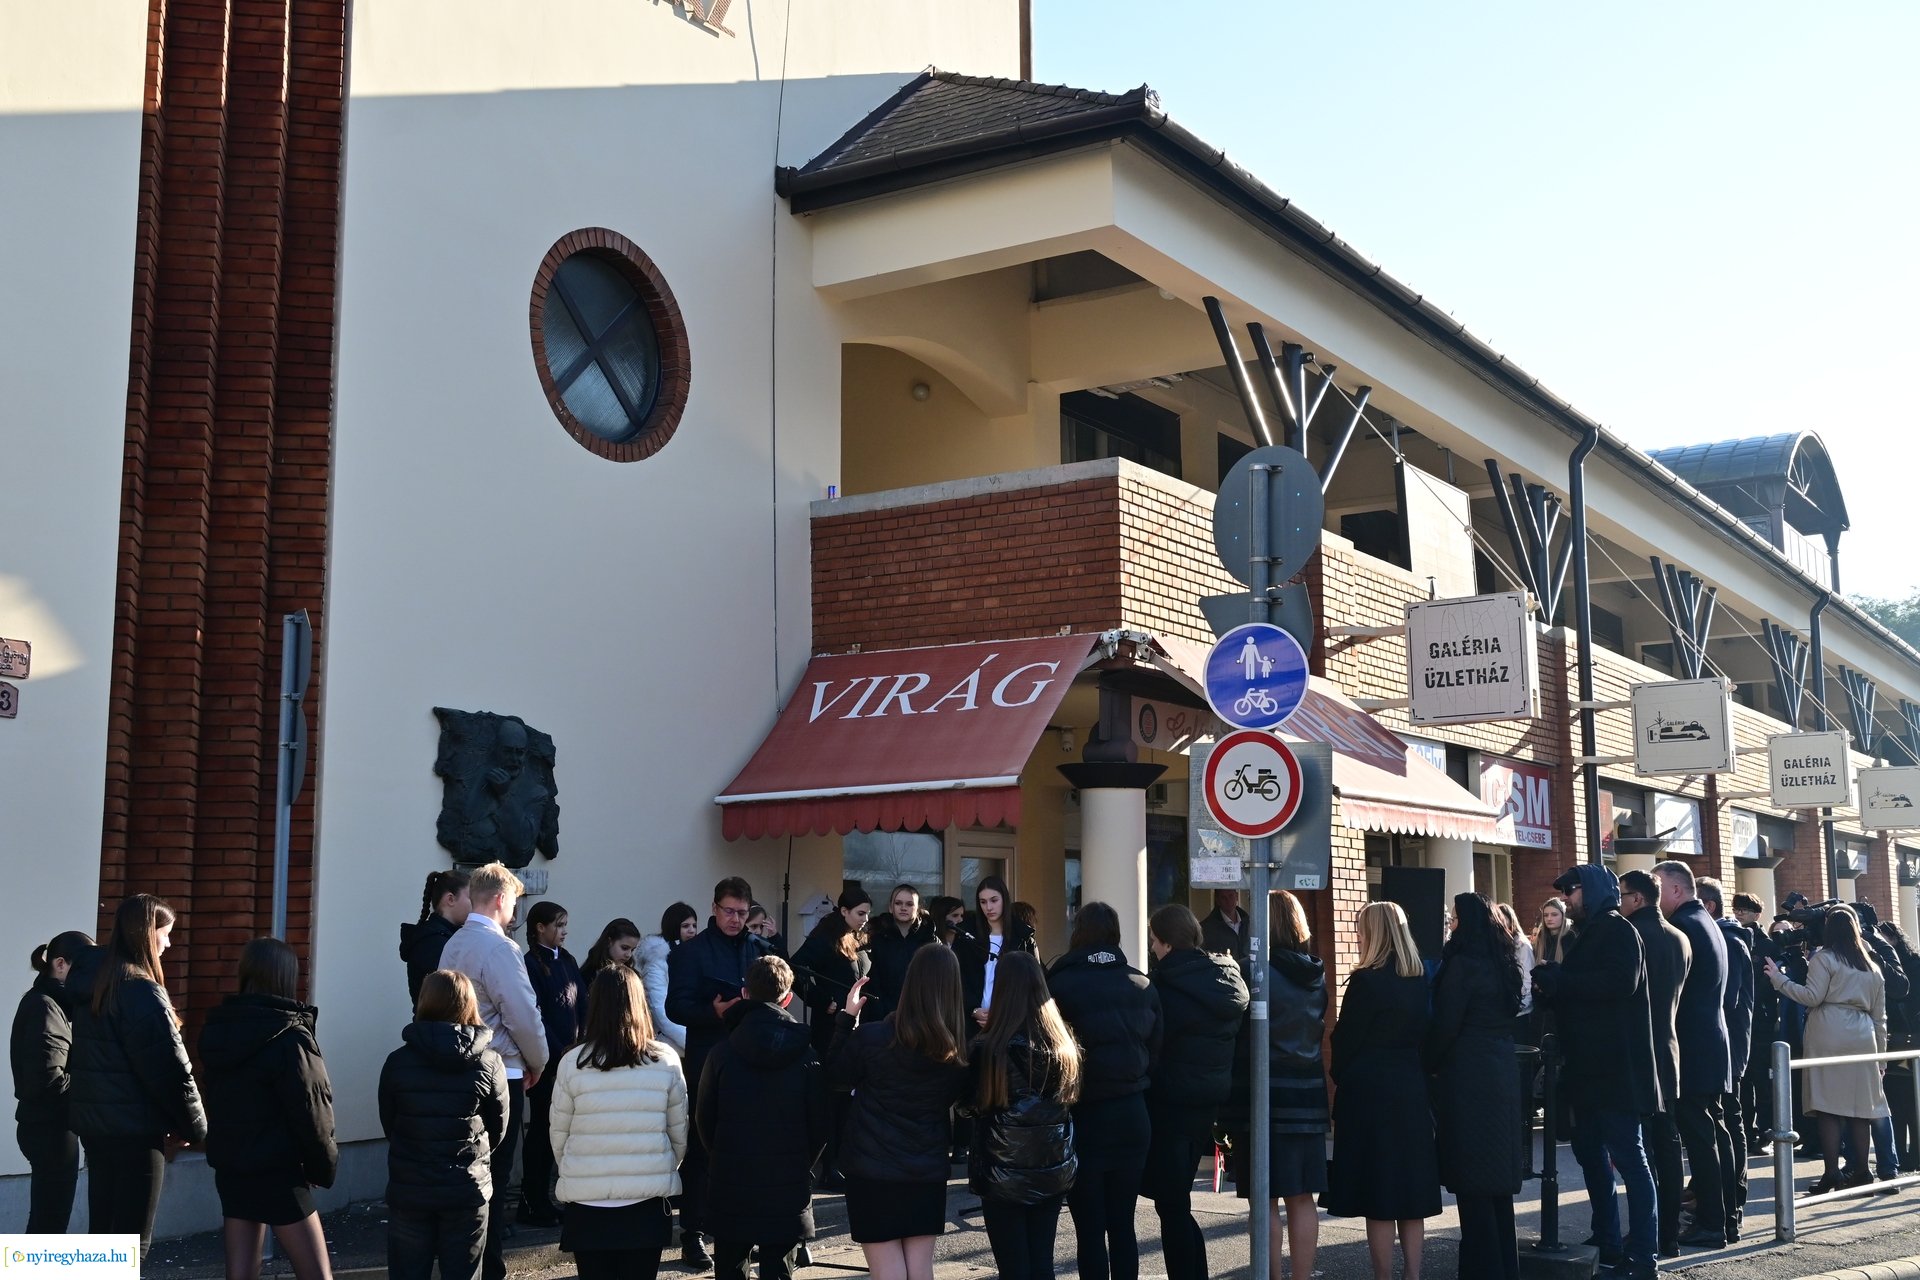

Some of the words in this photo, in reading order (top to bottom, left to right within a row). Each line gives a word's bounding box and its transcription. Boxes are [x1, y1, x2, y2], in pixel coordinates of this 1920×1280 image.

[1429, 635, 1502, 660] GALÉRIA
[1424, 661, 1510, 689] ÜZLETHÁZ
[808, 653, 1061, 724] VIRÁG
[1783, 755, 1831, 770] GALÉRIA
[1781, 772, 1837, 787] ÜZLETHÁZ
